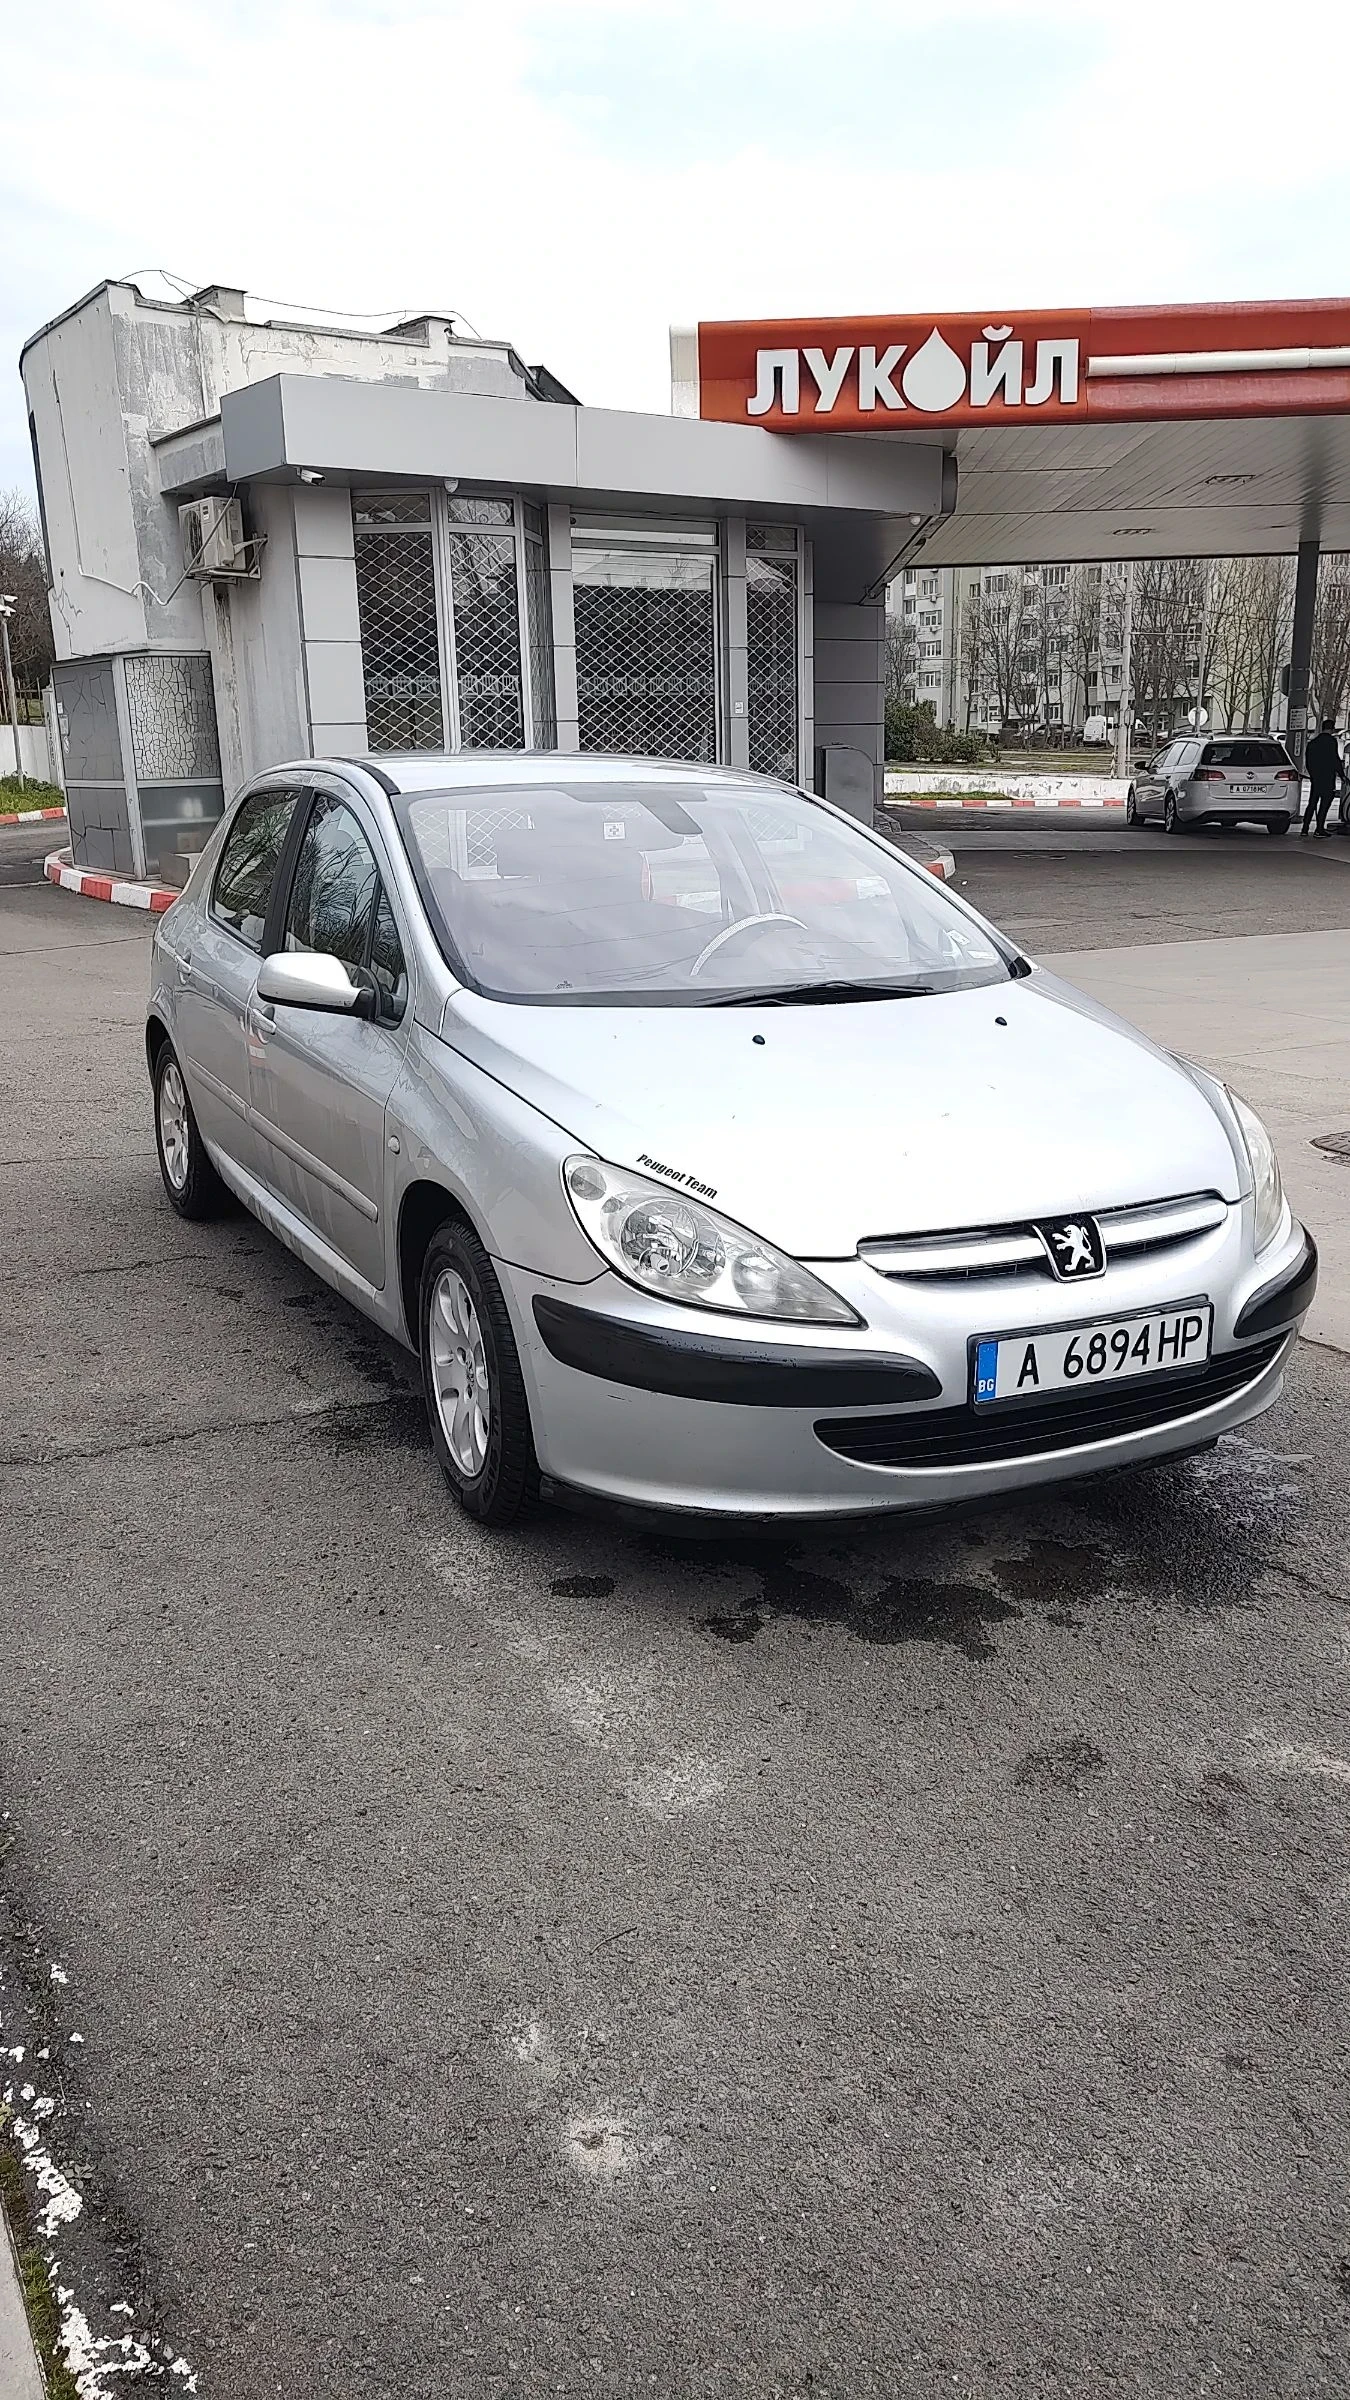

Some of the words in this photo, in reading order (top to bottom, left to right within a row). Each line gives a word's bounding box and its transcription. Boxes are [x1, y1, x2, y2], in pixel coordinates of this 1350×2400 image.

[747, 325, 1079, 415] ЛУКОЙЛ
[636, 1154, 687, 1182] Peugeot
[684, 1175, 718, 1200] Team
[978, 1378, 995, 1393] BG
[1016, 1343, 1040, 1388] A
